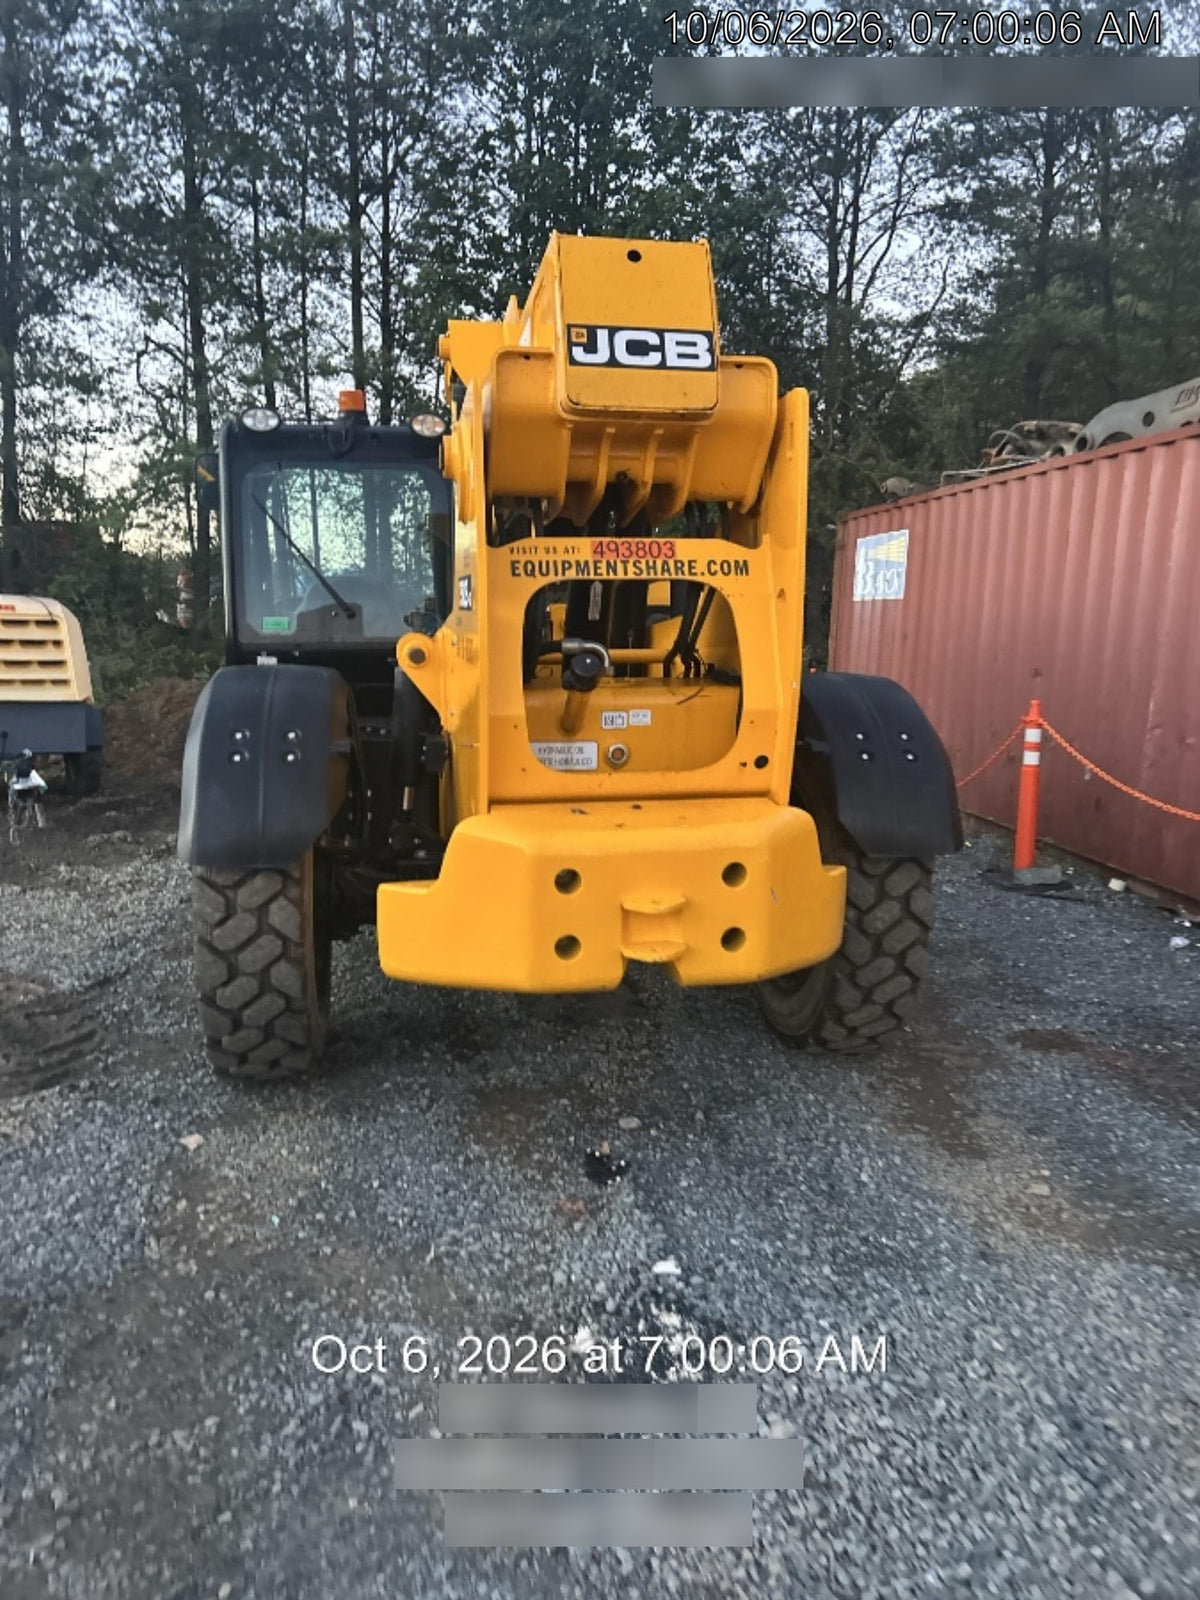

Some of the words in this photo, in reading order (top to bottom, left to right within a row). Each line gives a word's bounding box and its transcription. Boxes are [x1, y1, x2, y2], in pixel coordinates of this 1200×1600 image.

[571, 327, 713, 369] JCB
[508, 545, 538, 555] VISIT
[544, 545, 558, 555] US
[593, 540, 676, 559] 493803
[510, 559, 750, 578] EQUIPMENTSHARE.COM
